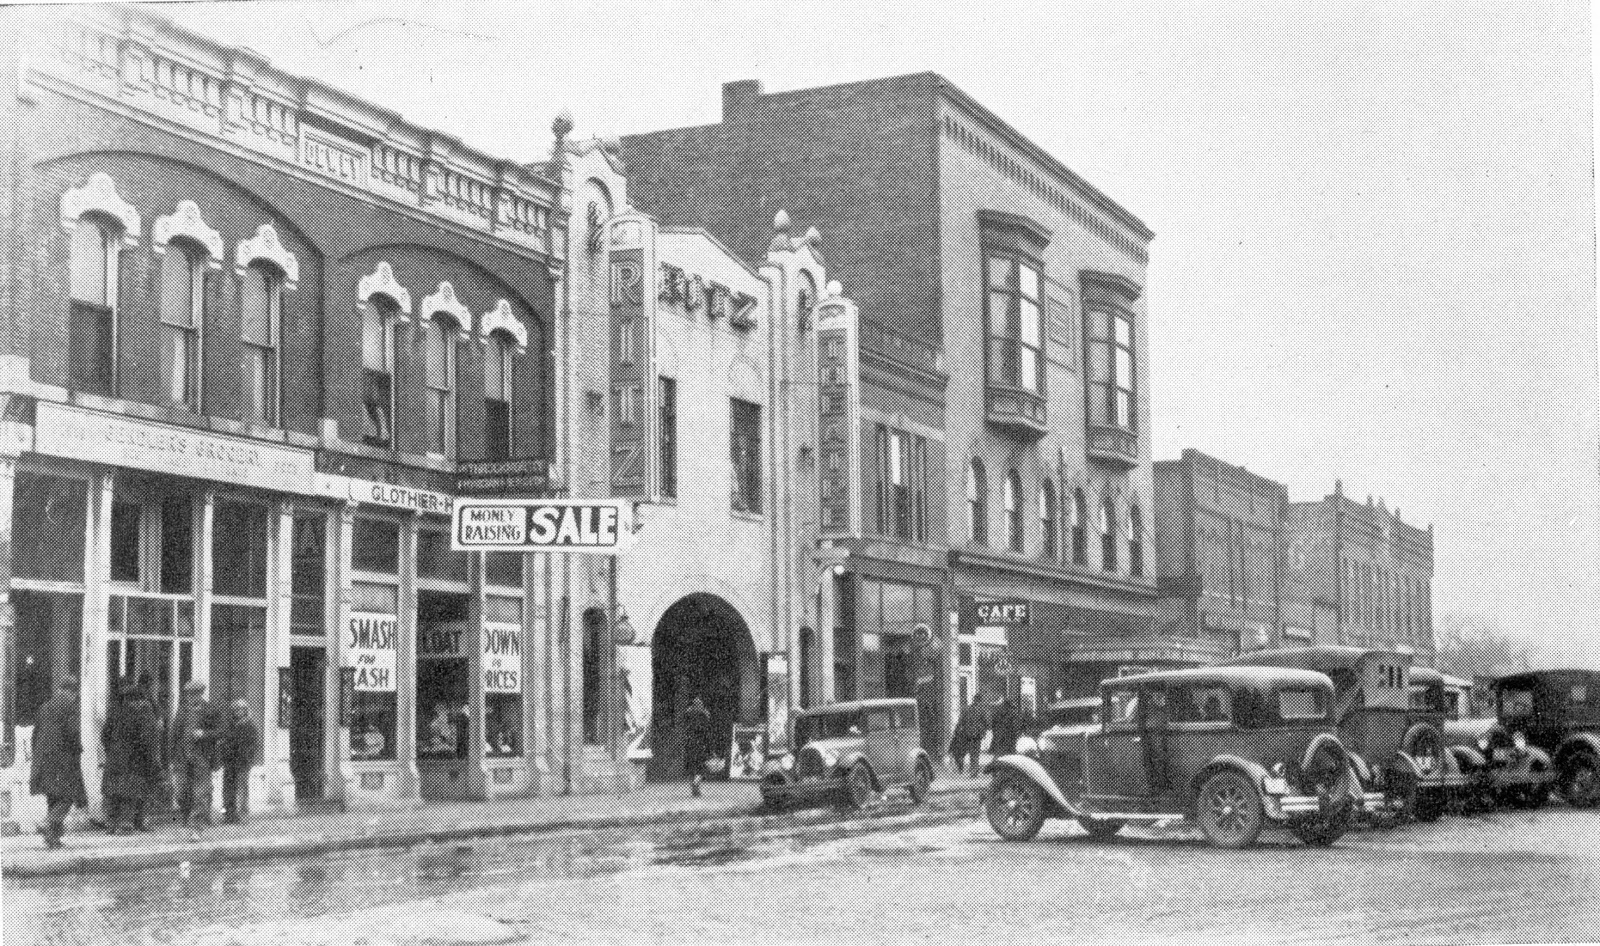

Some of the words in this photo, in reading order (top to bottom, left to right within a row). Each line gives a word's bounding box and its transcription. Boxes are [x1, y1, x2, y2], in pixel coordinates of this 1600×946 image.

[657, 261, 758, 332] RITZ
[470, 509, 514, 521] MONEY
[465, 524, 521, 541] RAISING
[529, 506, 617, 544] SALE
[977, 604, 1026, 618] CAFE
[349, 618, 397, 649] SMASH
[353, 667, 389, 687] ASH
[484, 669, 517, 688] RICES
